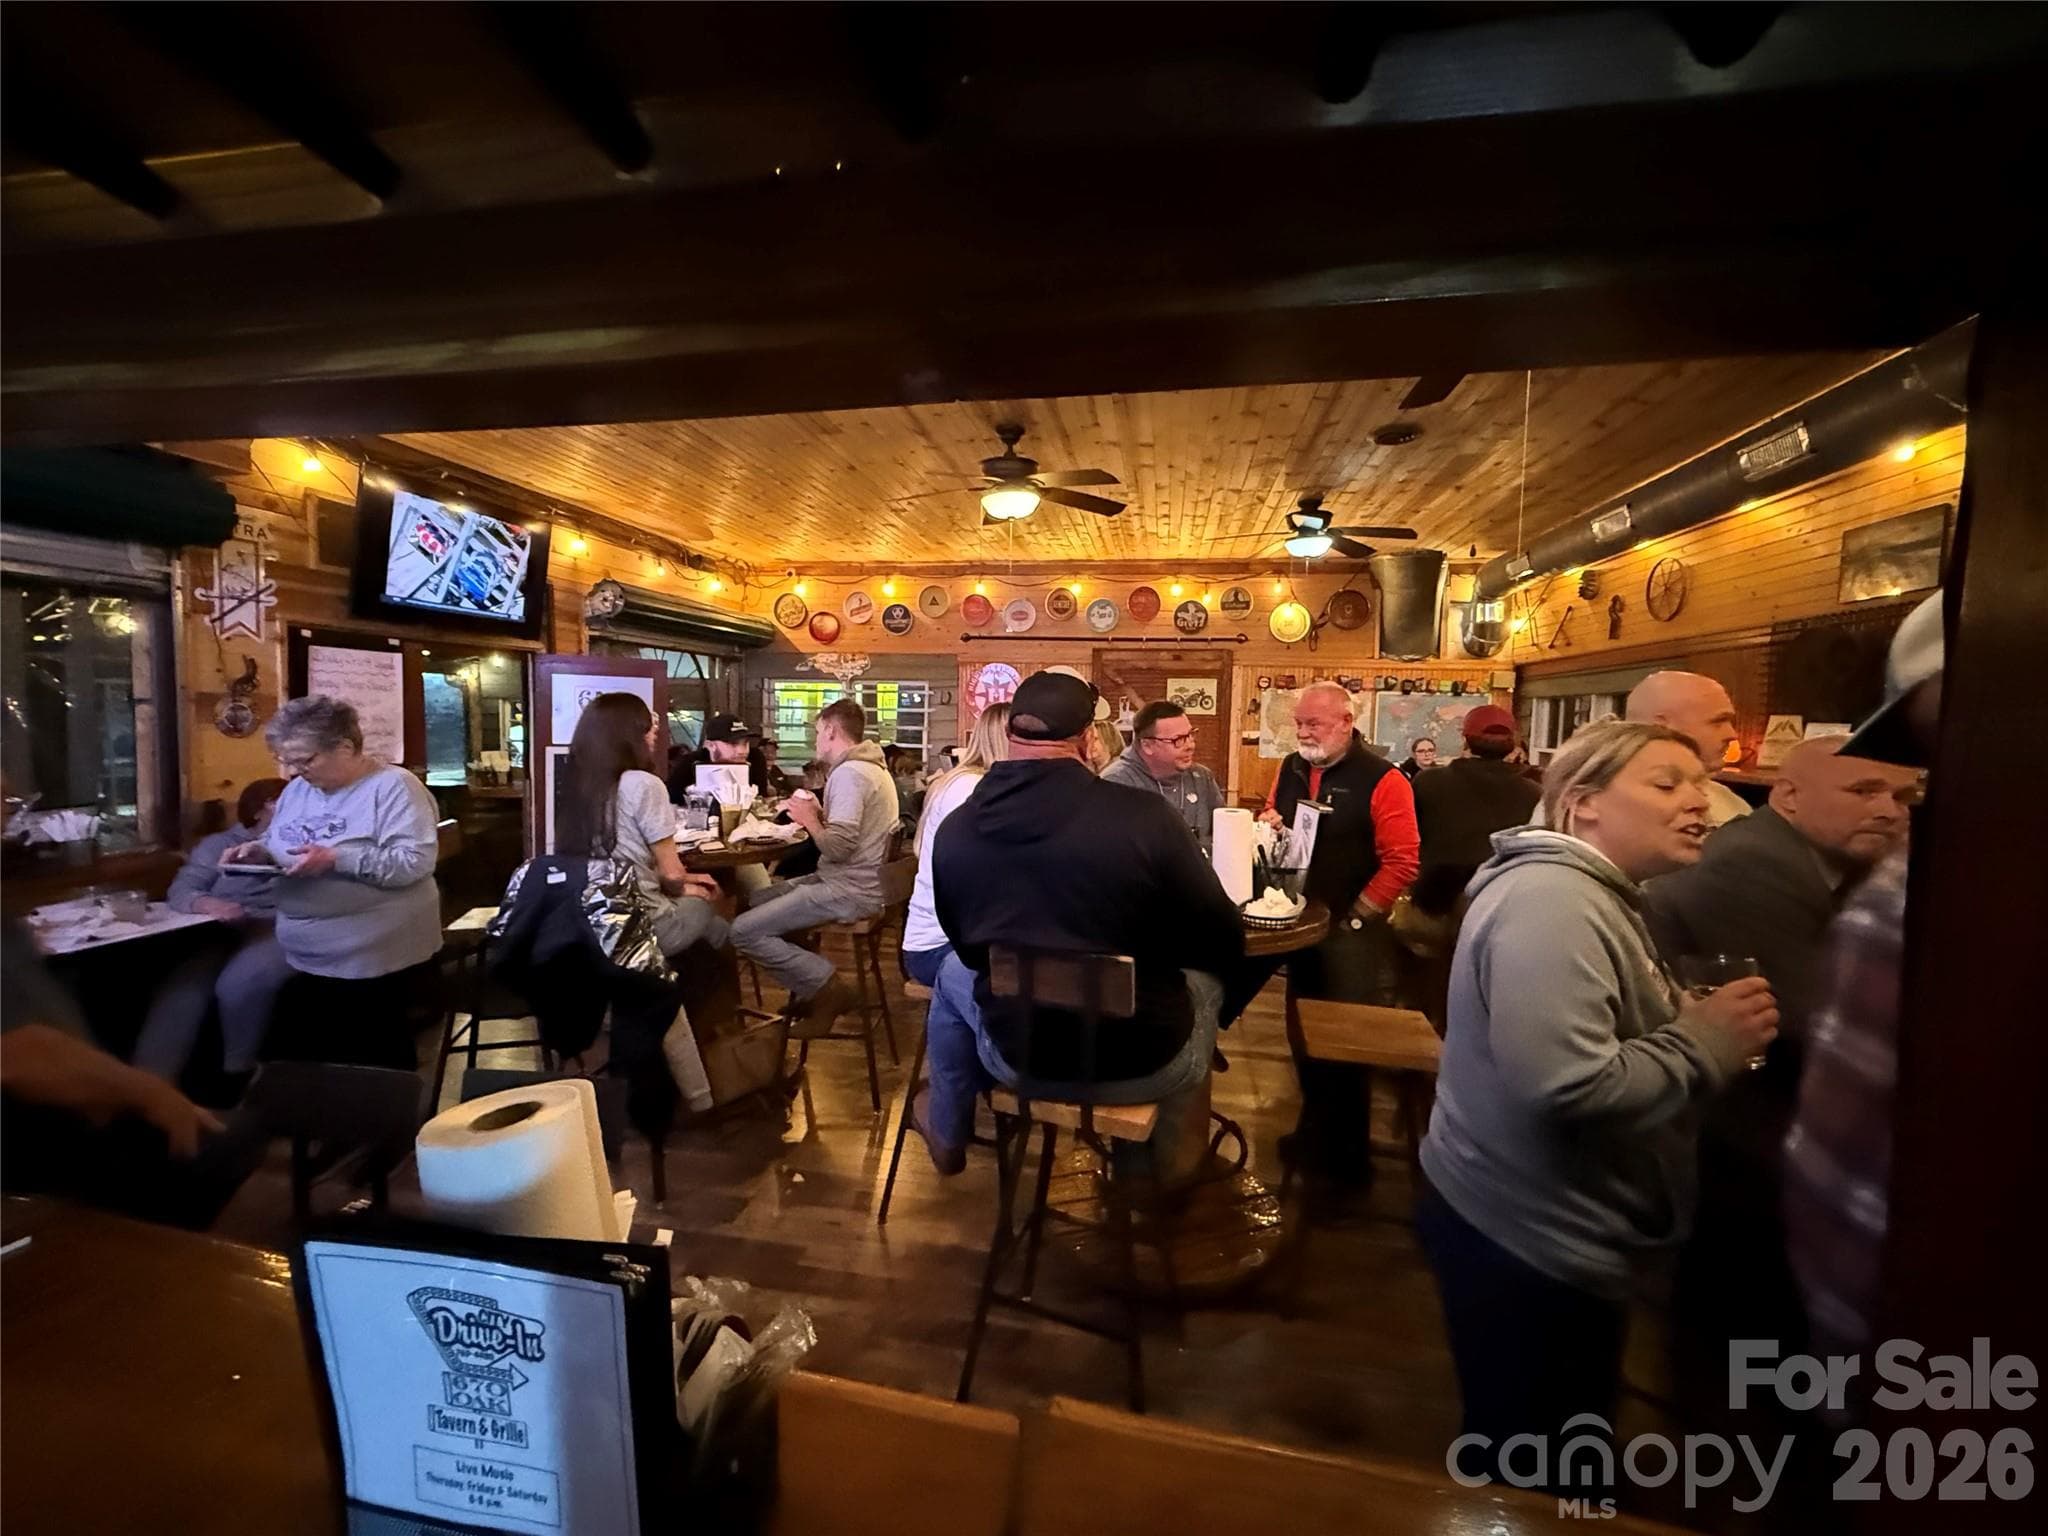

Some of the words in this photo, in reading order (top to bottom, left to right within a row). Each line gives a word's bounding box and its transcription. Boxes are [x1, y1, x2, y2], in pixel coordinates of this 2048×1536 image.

[479, 1309, 510, 1328] CITY
[428, 1307, 544, 1361] Drive-In
[452, 1392, 508, 1413] OAK
[436, 1410, 476, 1434] Tavern
[479, 1417, 488, 1436] &
[490, 1419, 524, 1443] Grille
[455, 1460, 478, 1476] Live
[481, 1464, 515, 1482] Music
[467, 1480, 496, 1496] Friday
[507, 1486, 548, 1505] Saturday
